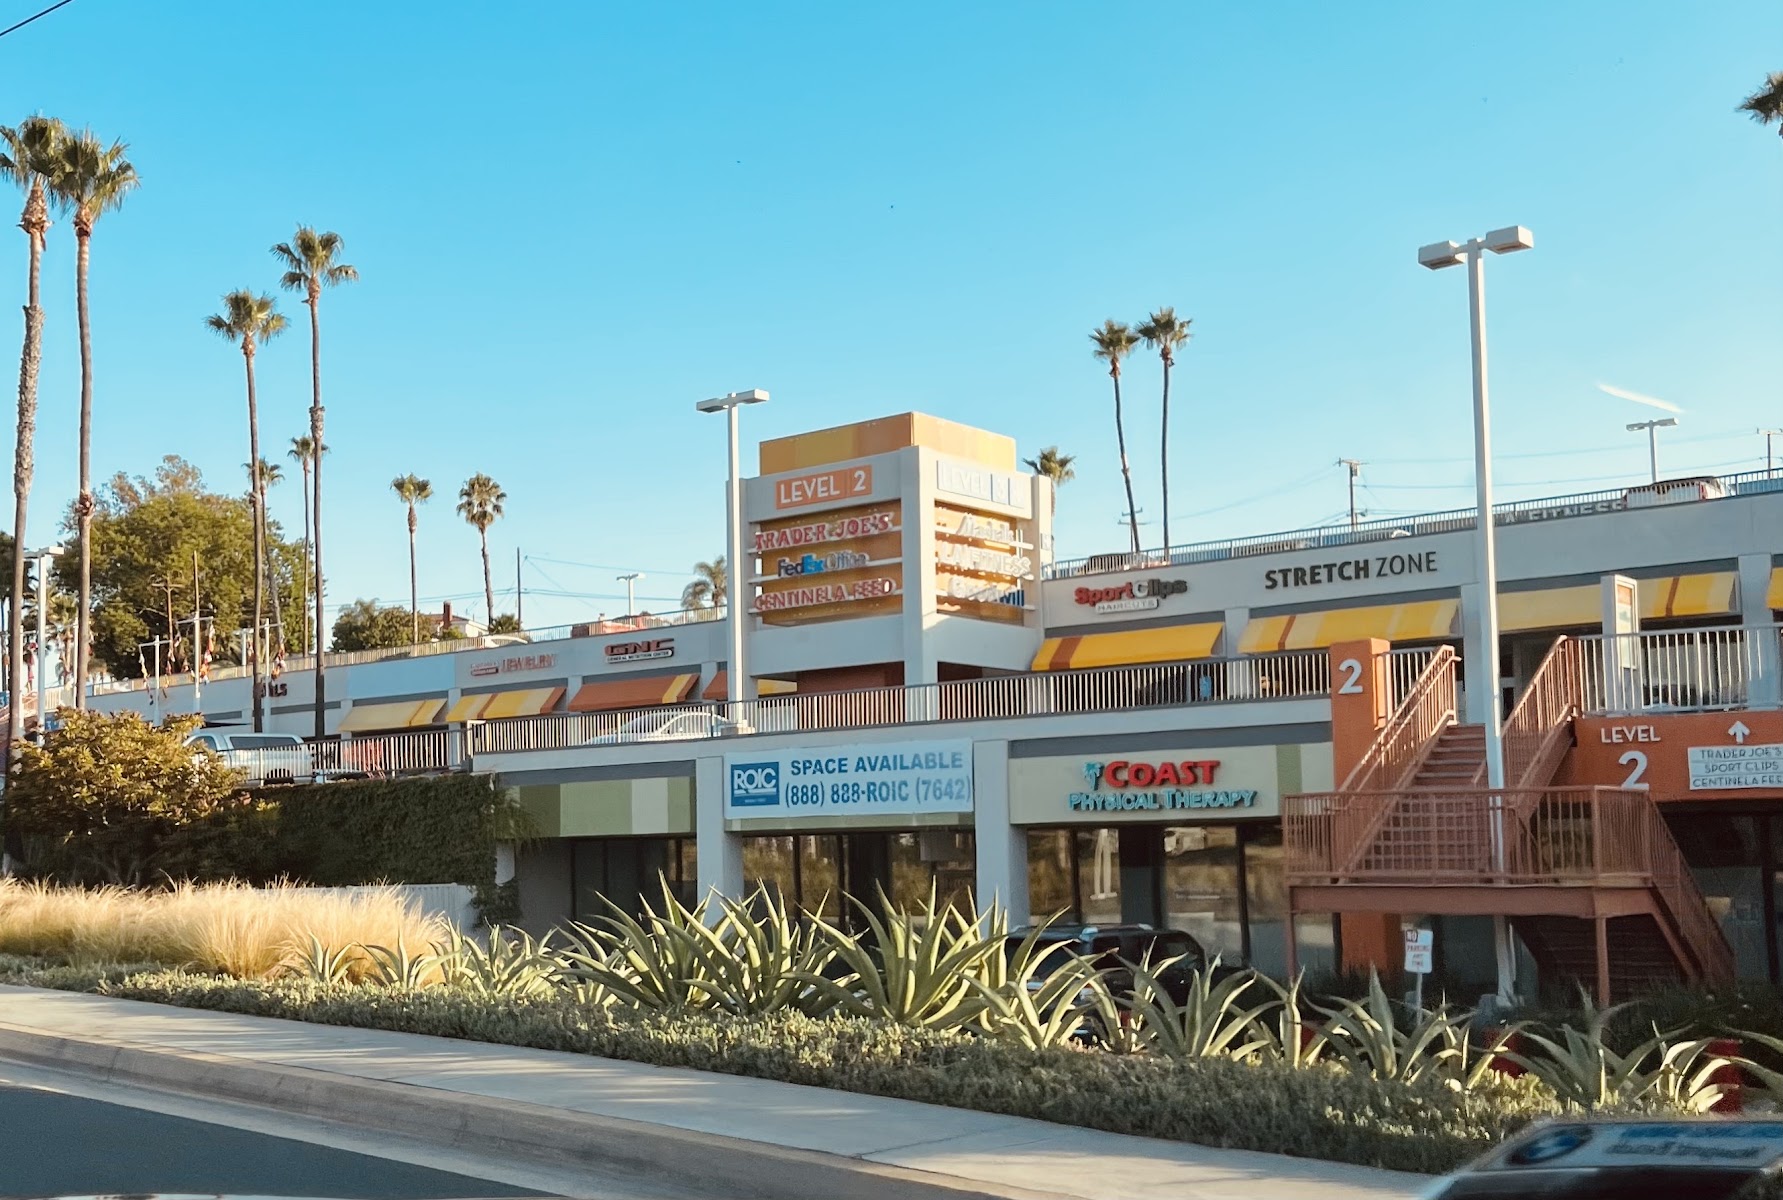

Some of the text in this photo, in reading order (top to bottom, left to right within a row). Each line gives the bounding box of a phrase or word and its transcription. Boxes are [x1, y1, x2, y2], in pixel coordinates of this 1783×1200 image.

[780, 470, 866, 504] LEVEL 2
[755, 513, 893, 550] TRADER JOE'S
[777, 554, 825, 577] FedEx
[1265, 551, 1437, 590] STRETCH ZONE
[754, 577, 895, 611] CENTINELA FEED
[605, 639, 674, 656] GNC
[1338, 658, 1363, 695] 2
[1601, 725, 1661, 744] LEVEL
[791, 752, 964, 776] SPACE AVAILABLE
[1701, 747, 1782, 760] TRADER JOE'S
[733, 767, 777, 789] ROIC
[1104, 760, 1220, 788] COAST
[1618, 750, 1650, 791] 2
[1705, 761, 1779, 774] SPORT CLIPS
[785, 775, 972, 808] (888) 888-ROIC (7642)
[1693, 777, 1759, 788] CENTINELA
[1068, 788, 1258, 812] PHYSICAL THERAPY
